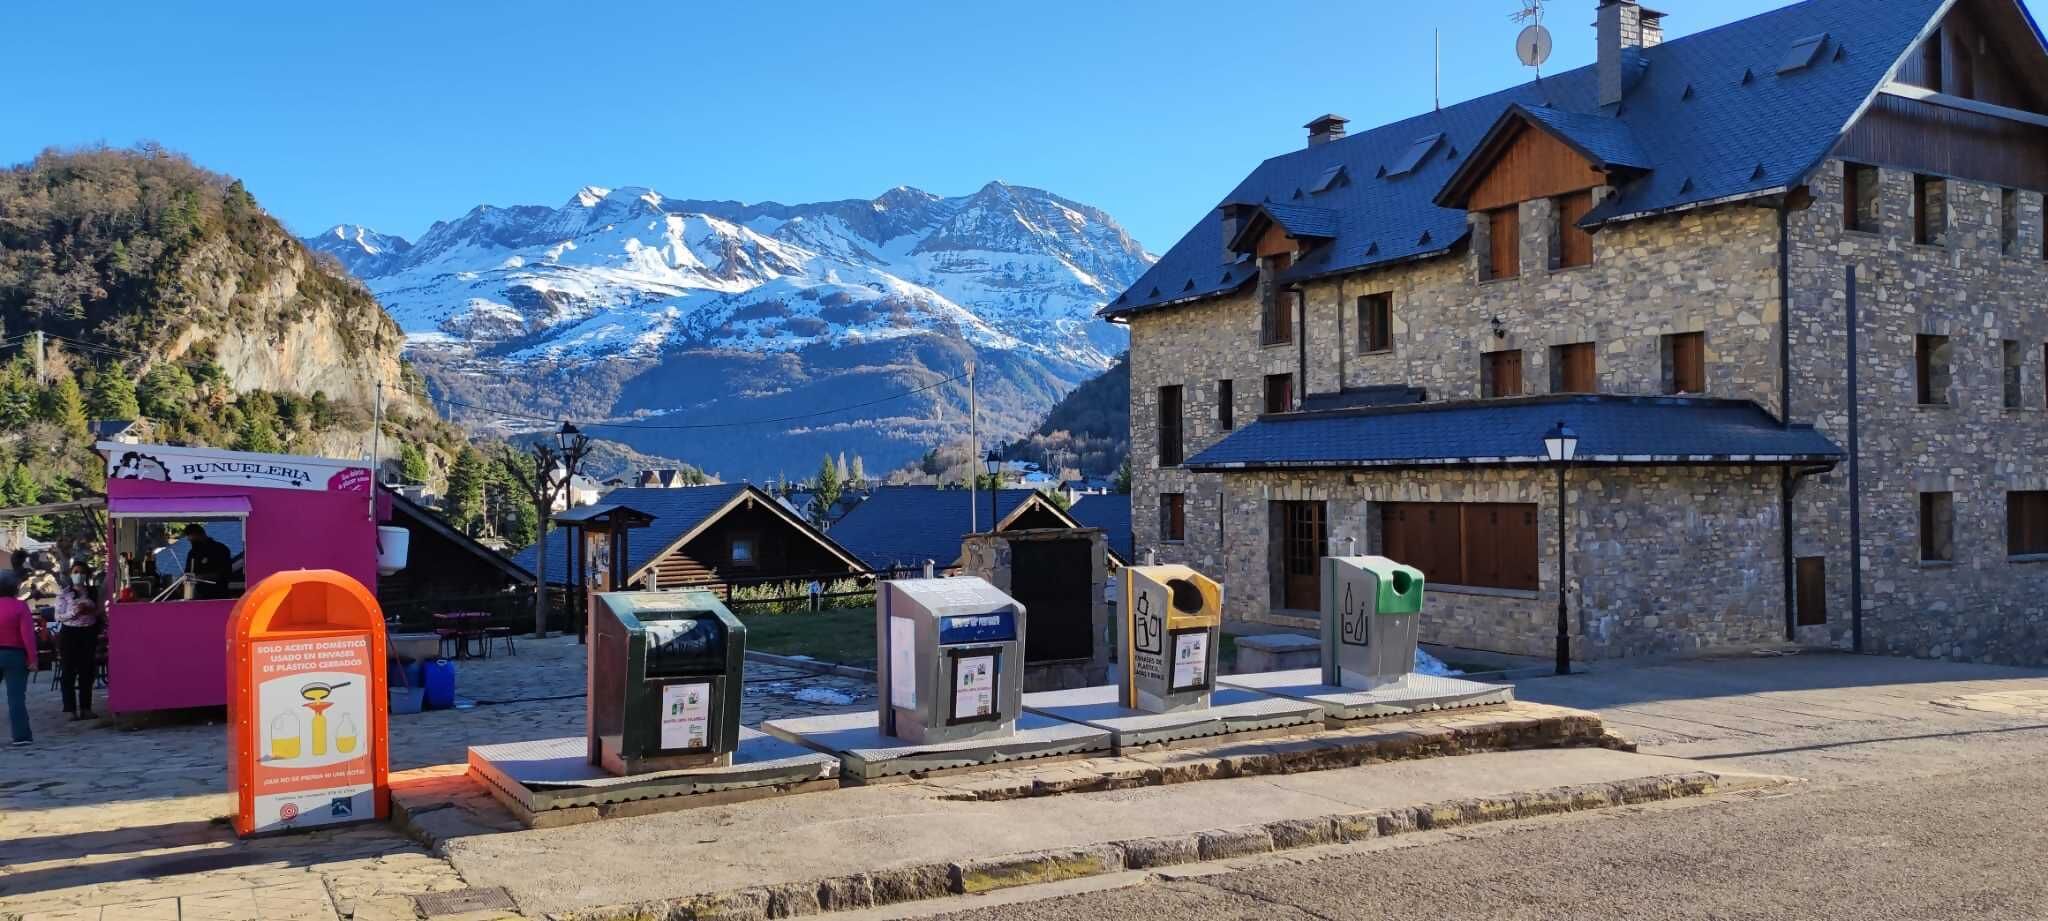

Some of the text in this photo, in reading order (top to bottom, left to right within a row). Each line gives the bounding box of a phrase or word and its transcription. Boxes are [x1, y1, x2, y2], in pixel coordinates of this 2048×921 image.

[285, 643, 313, 651] ACEITE
[271, 654, 301, 662] USADO
[318, 650, 354, 659] ENVASES
[319, 659, 362, 668] CERRADOS
